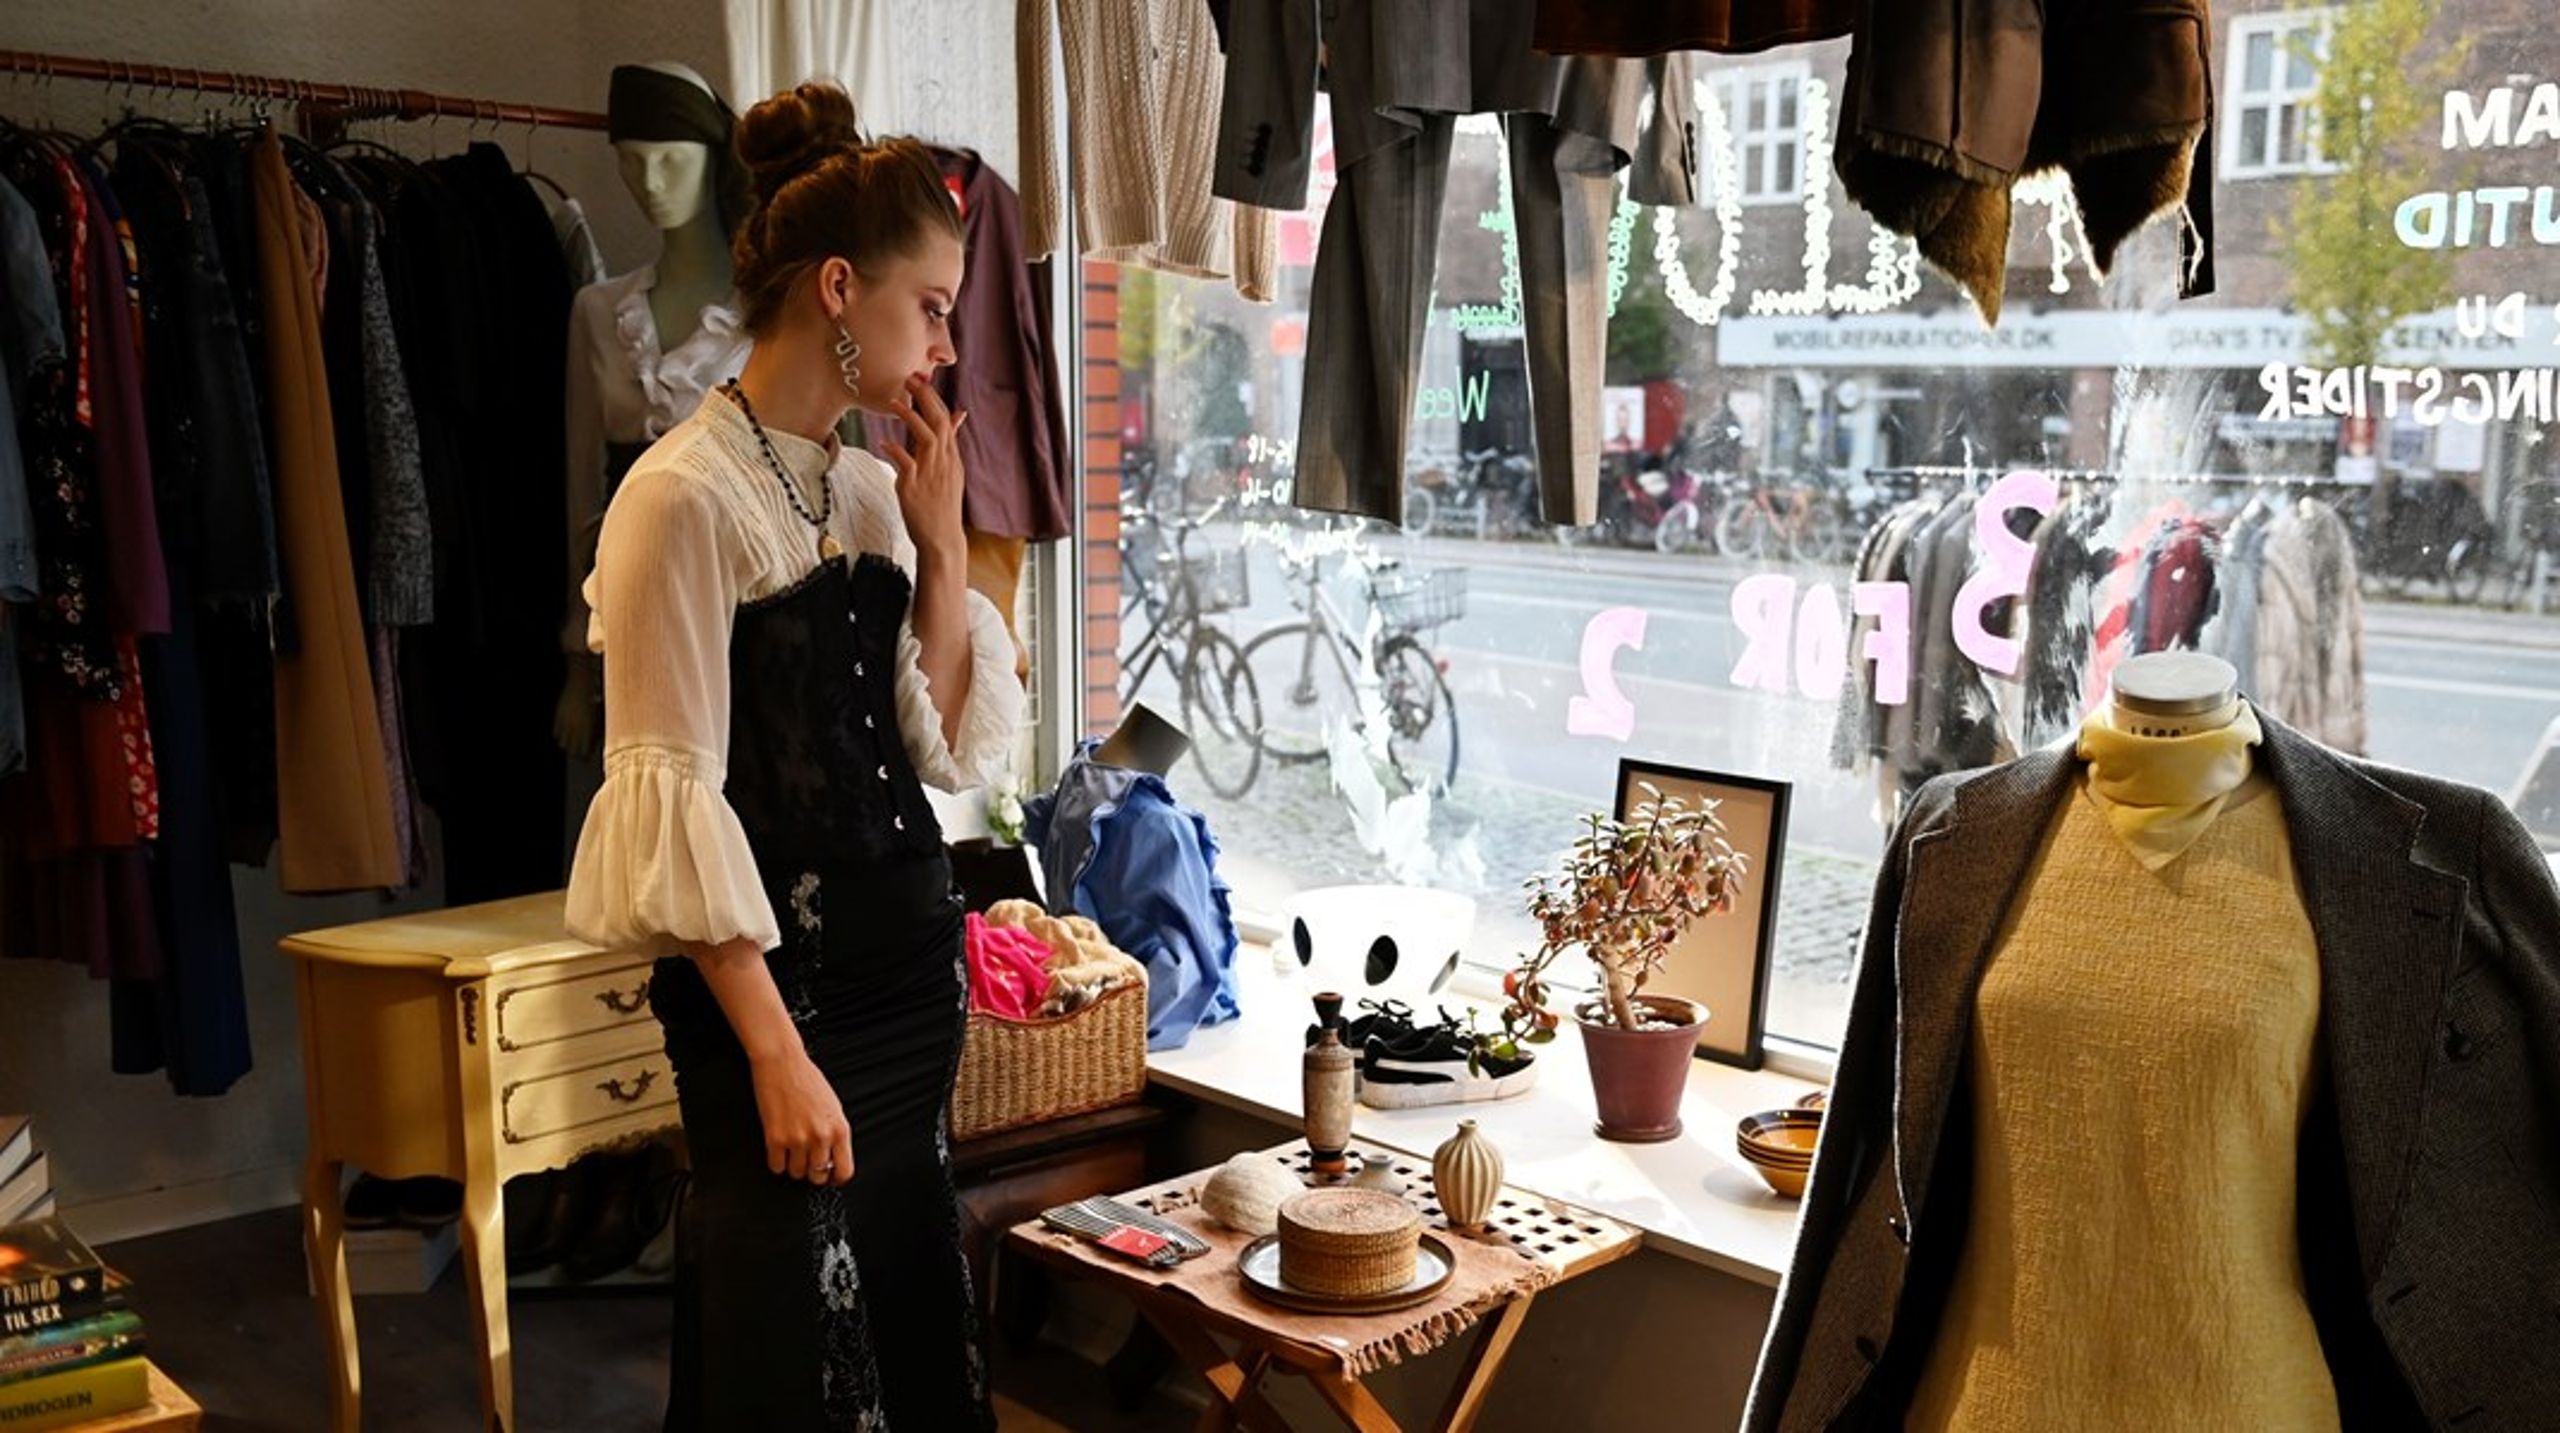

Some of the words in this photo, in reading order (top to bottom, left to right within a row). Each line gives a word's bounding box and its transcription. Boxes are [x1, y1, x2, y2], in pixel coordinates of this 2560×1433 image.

[2261, 326, 2293, 349] TV
[4, 1311, 30, 1332] TIL
[31, 1303, 63, 1326] SEX
